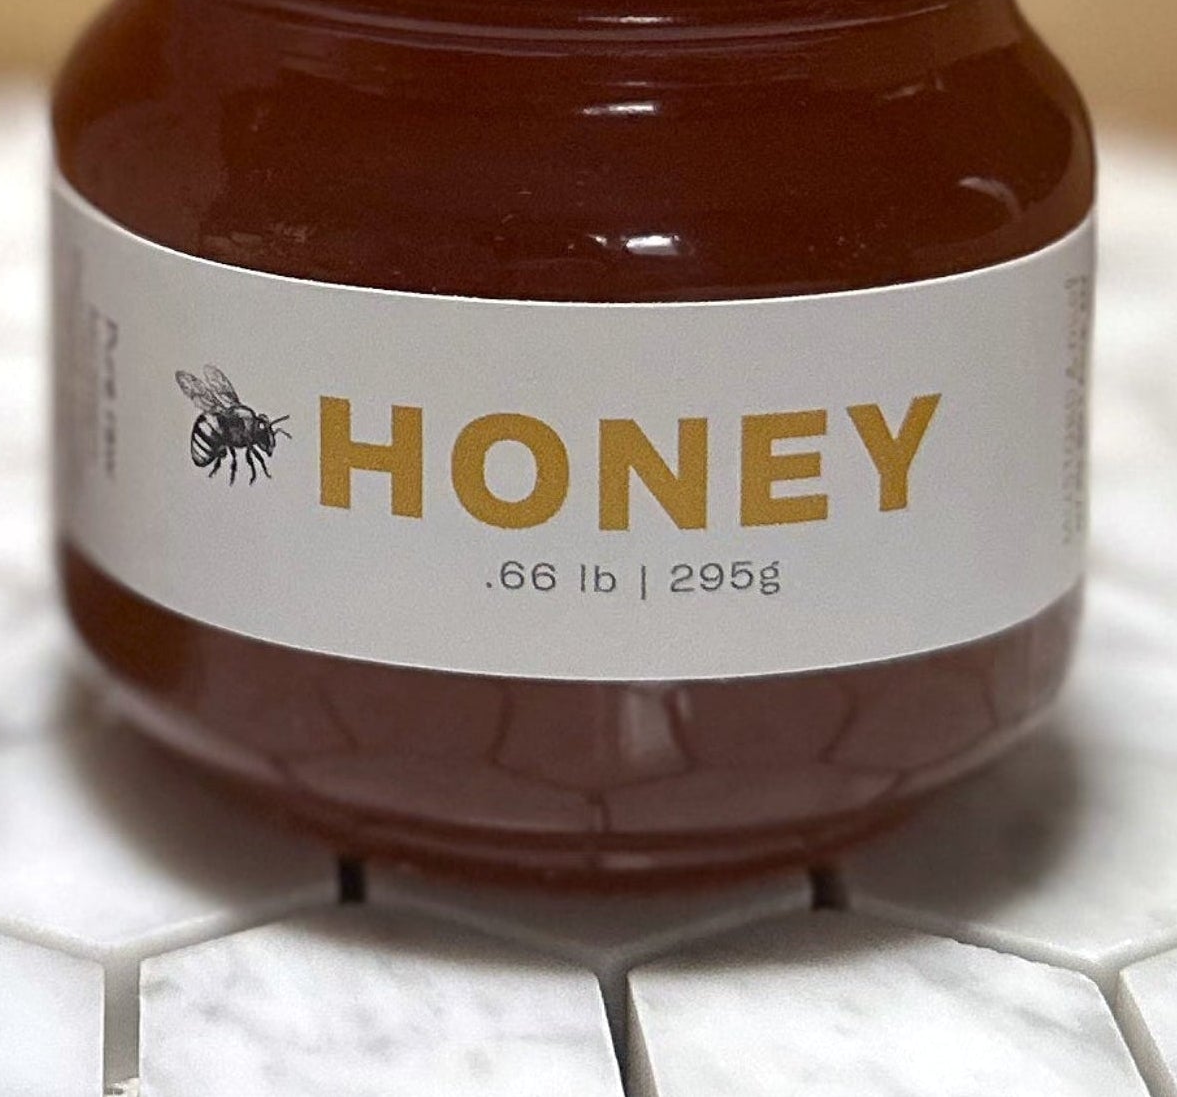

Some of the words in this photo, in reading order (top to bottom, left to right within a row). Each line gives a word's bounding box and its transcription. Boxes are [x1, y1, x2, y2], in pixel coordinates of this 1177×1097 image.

[319, 394, 941, 531] HONEY
[485, 560, 557, 592] .66
[580, 563, 617, 594] lb
[670, 560, 781, 596] 295g
